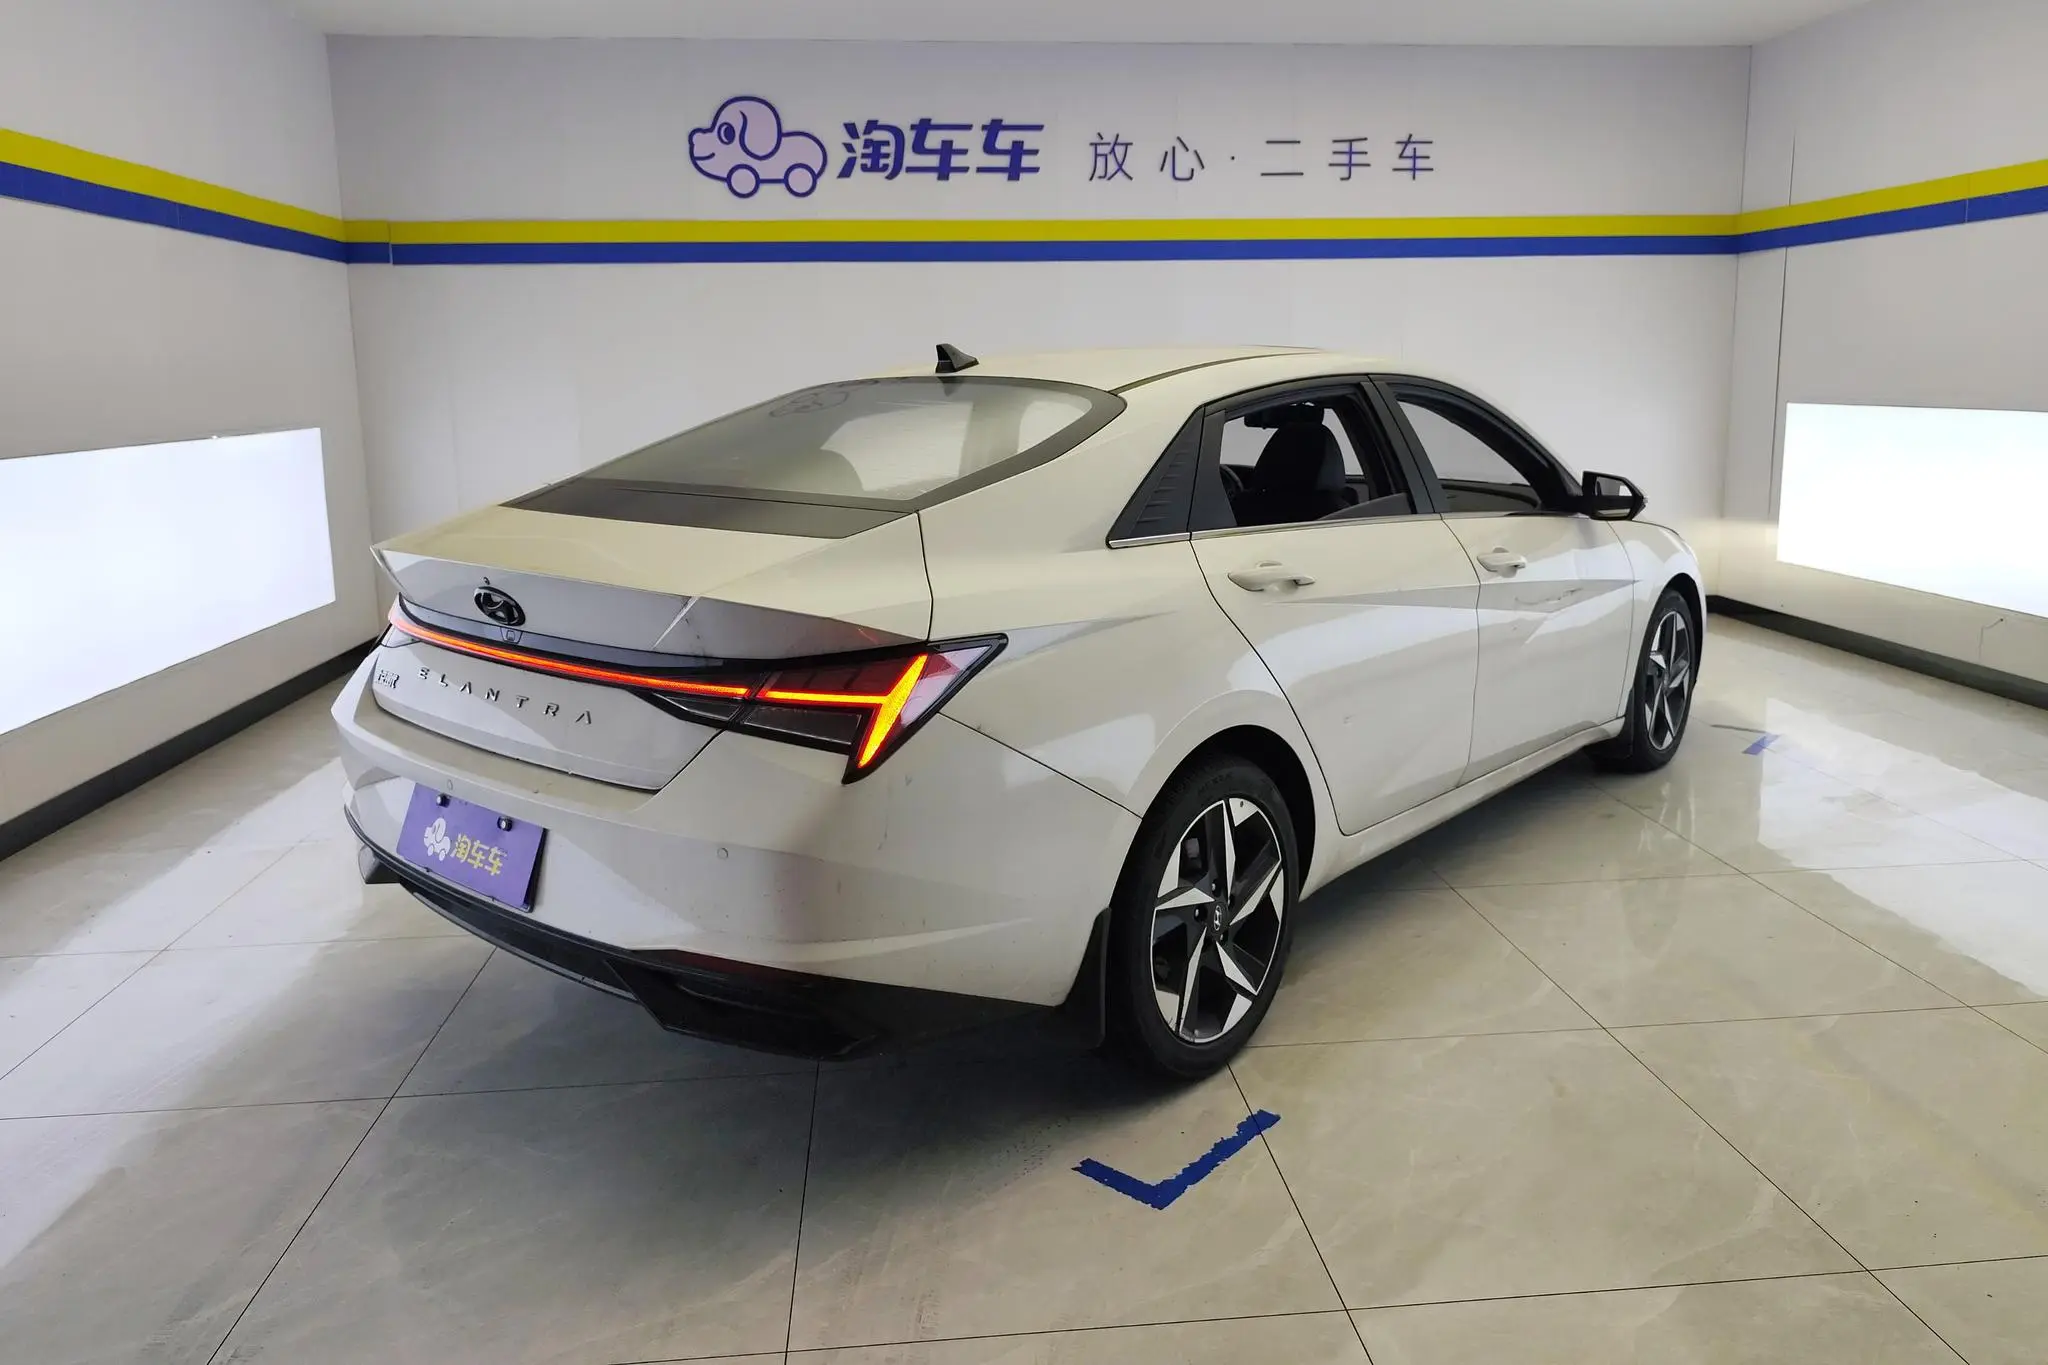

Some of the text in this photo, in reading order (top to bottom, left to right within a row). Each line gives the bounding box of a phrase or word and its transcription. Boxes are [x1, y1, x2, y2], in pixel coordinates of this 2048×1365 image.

[837, 118, 1044, 181] 淘车车
[418, 667, 592, 725] ELANTRA
[450, 833, 507, 876] 淘车车
